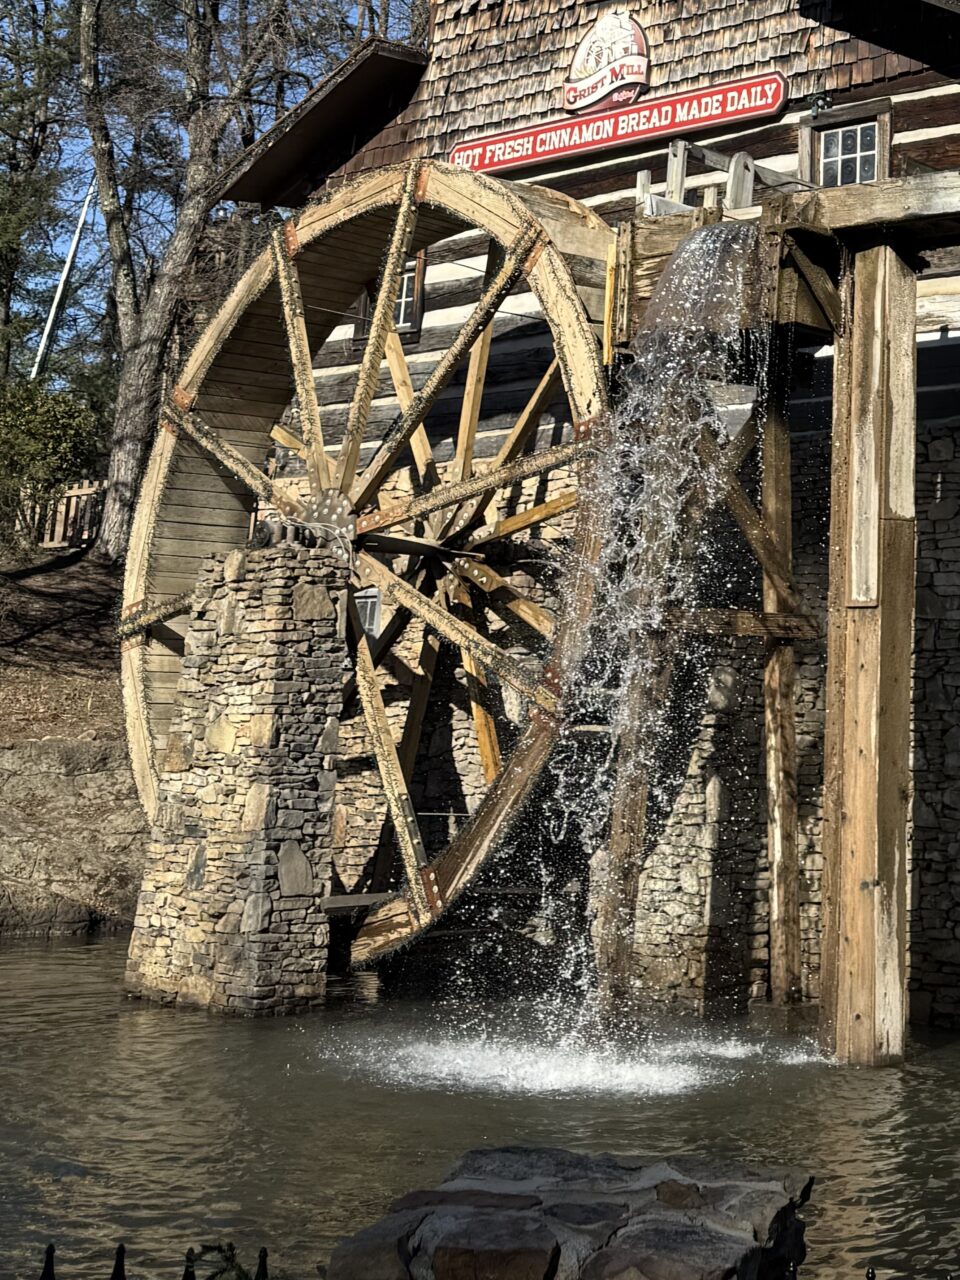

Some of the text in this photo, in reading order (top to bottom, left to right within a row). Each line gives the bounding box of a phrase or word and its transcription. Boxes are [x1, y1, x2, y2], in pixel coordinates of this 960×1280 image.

[566, 75, 607, 104] GRIST
[609, 63, 644, 85] MILL
[454, 82, 777, 169] HOT FRESH CINNAMON BREAD MADE DAILY
